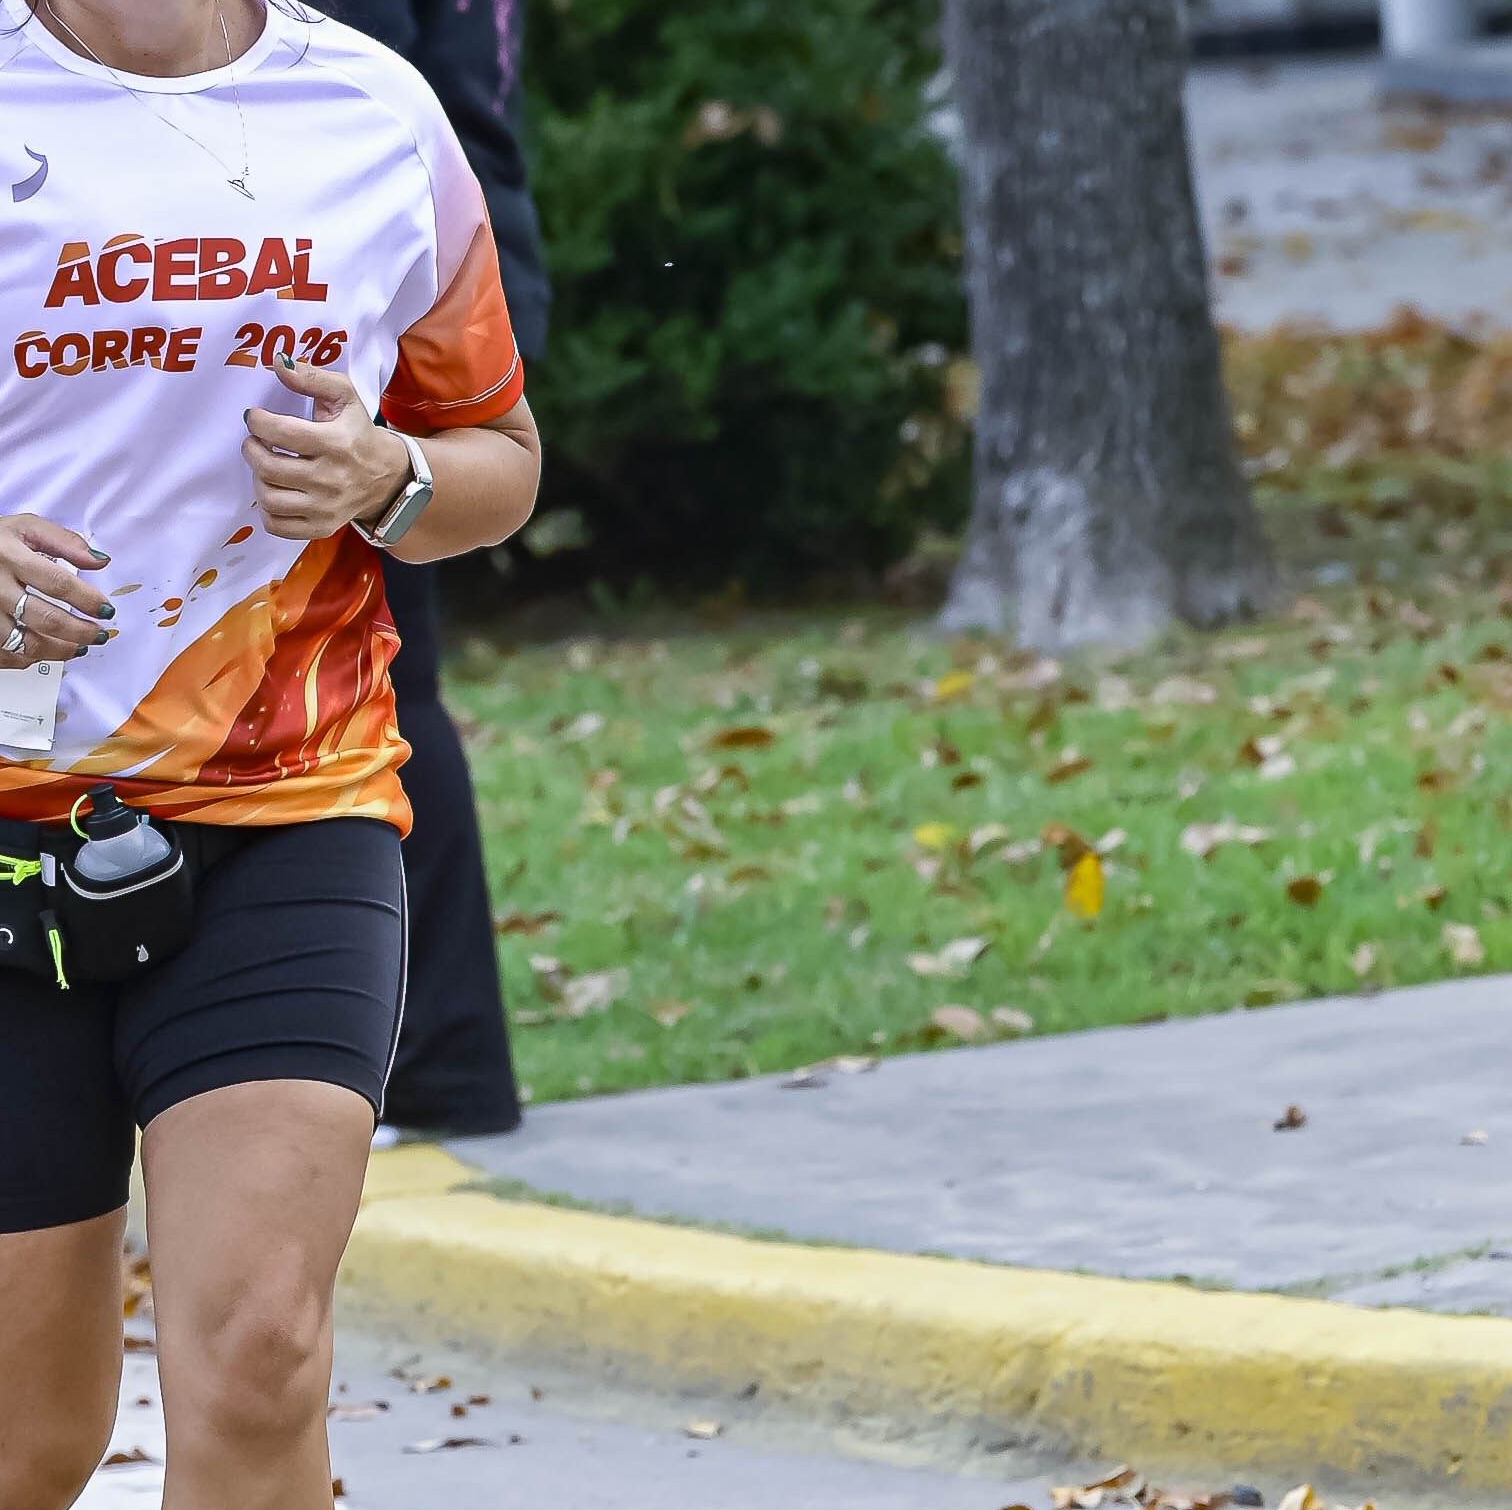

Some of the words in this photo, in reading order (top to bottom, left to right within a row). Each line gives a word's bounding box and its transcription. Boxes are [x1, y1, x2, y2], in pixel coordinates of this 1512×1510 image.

[43, 233, 329, 308] ACEBAL
[14, 326, 203, 378] CORRE
[224, 322, 348, 368] 2026
